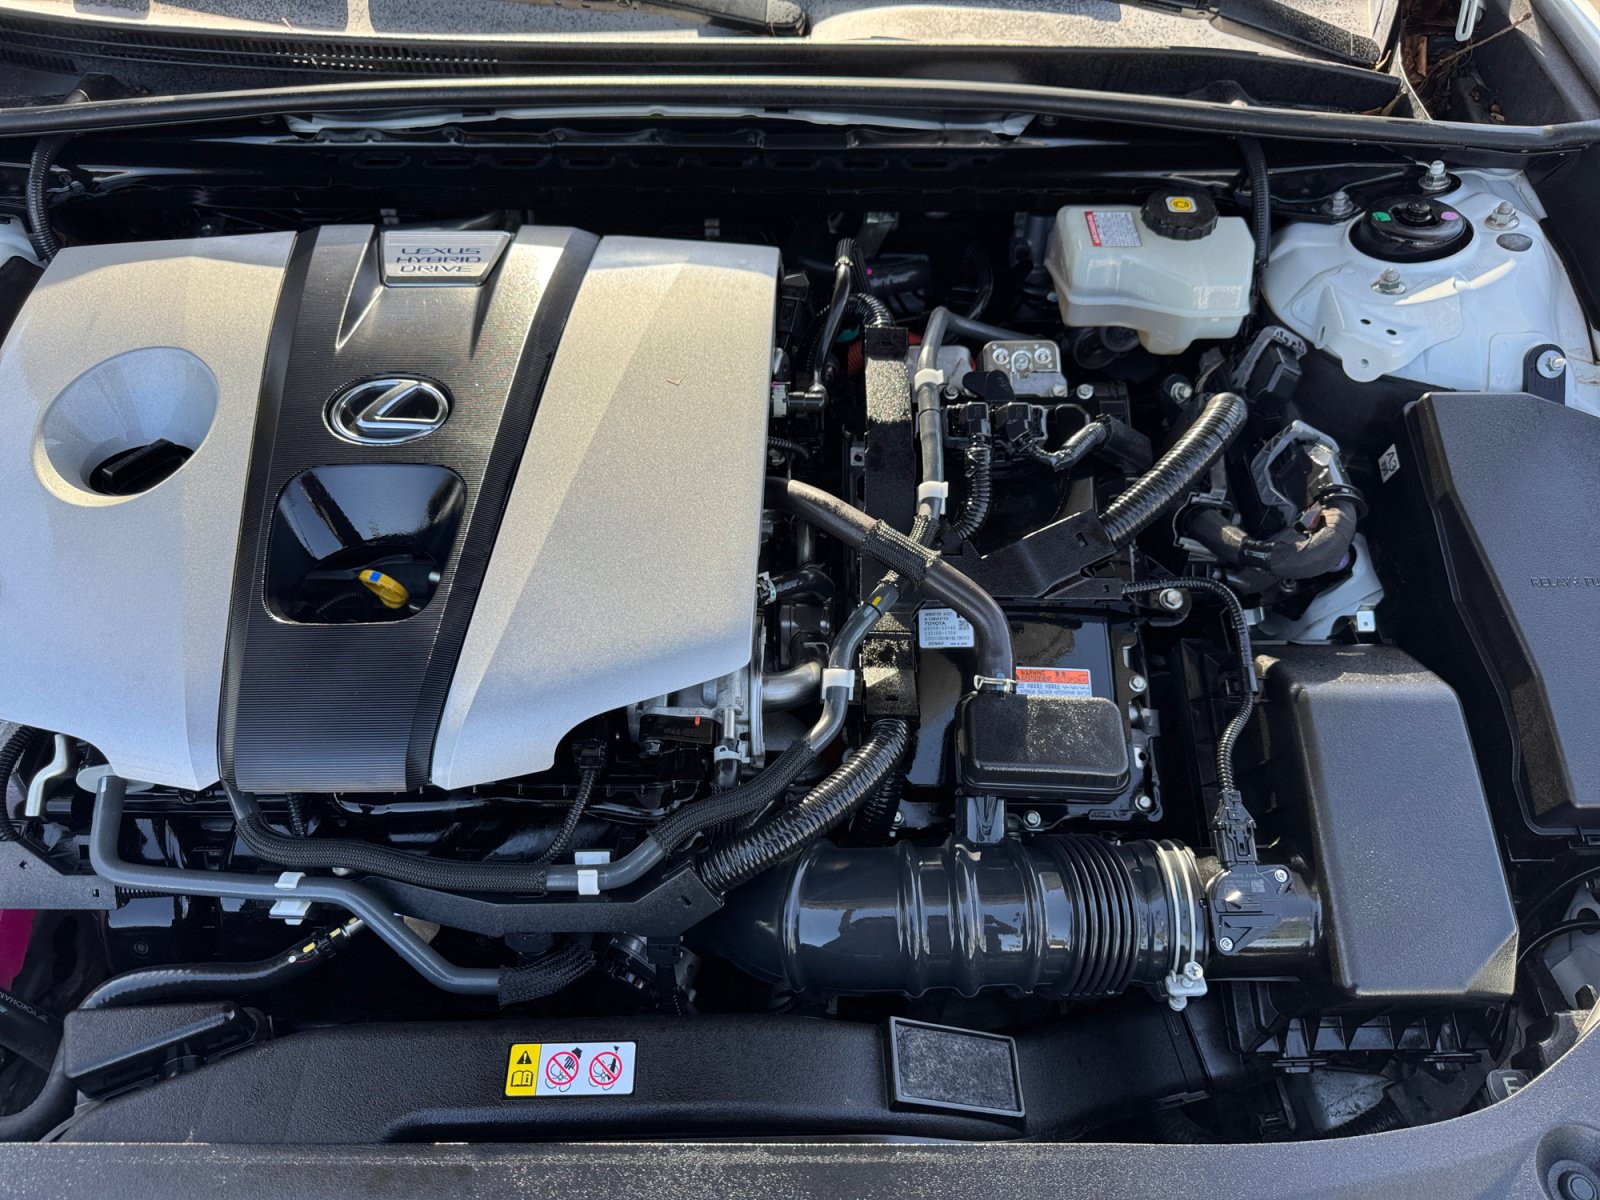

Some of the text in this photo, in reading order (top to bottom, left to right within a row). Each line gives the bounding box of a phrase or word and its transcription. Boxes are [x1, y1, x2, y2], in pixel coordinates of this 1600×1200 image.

[401, 247, 481, 255] LEXUS
[400, 265, 473, 273] DRIVE
[1530, 576, 1570, 588] RELAY
